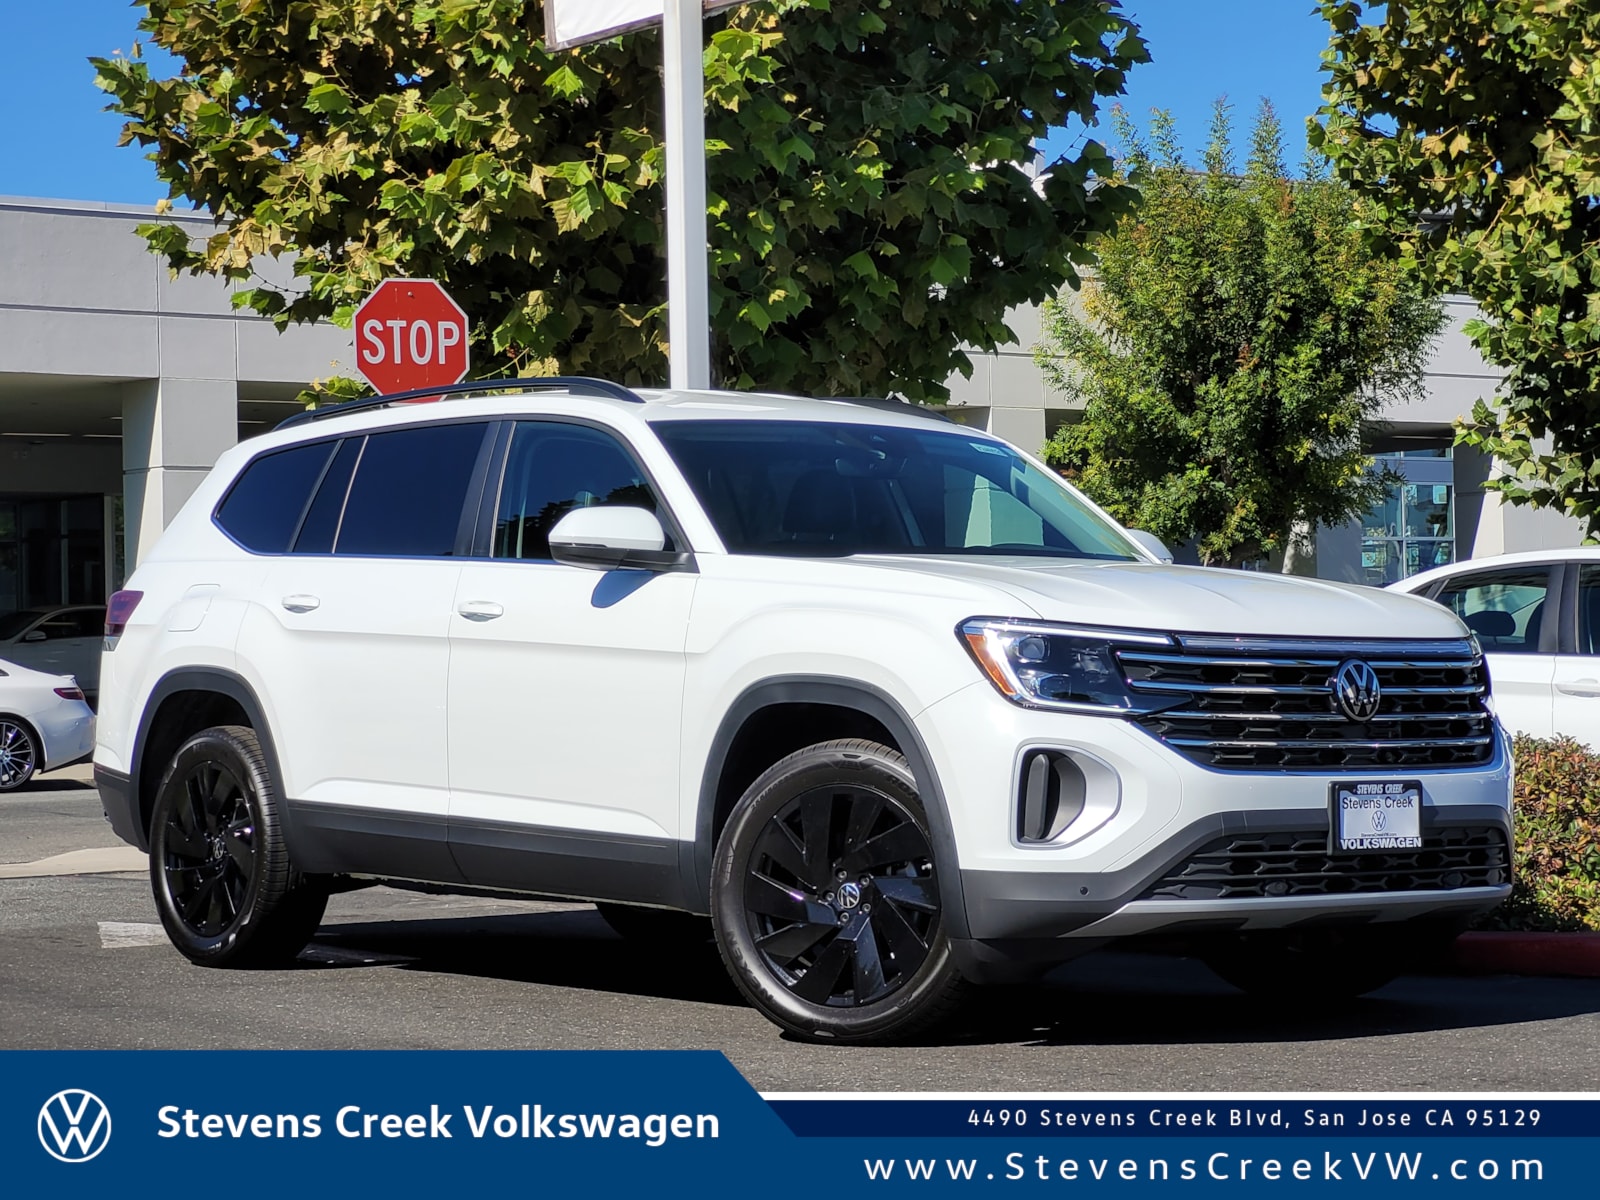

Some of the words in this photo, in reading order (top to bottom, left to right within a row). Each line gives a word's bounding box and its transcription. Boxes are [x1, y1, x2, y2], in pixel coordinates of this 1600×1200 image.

[362, 319, 460, 365] STOP
[1357, 784, 1384, 795] STEVENS
[1385, 783, 1404, 794] CREEK
[1342, 797, 1382, 810] Stevens
[1384, 796, 1414, 809] Creek
[1340, 837, 1422, 850] VOLKSWAGEN
